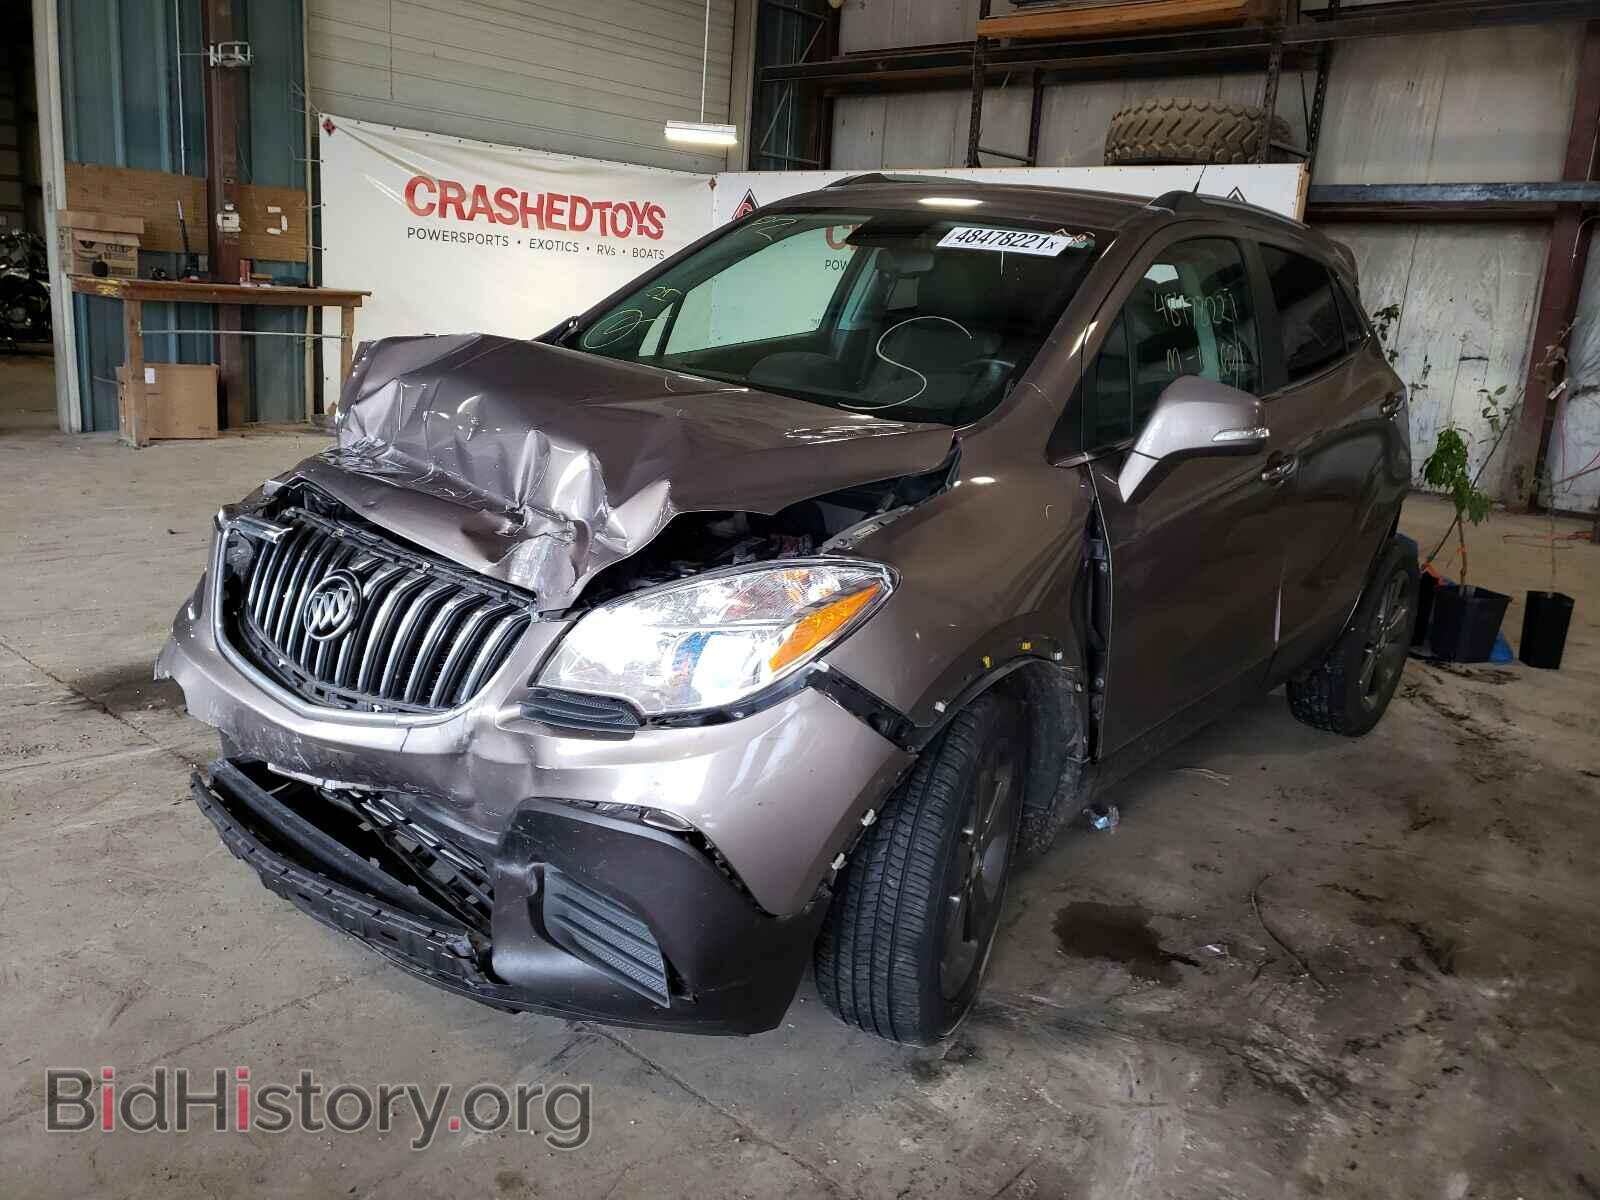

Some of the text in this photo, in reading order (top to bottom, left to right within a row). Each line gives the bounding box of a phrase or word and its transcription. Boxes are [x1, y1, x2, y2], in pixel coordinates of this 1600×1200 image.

[404, 175, 666, 240] CRASHEDTOYS
[407, 227, 665, 259] POWERSPORTS EXOTICS RVs BOATS
